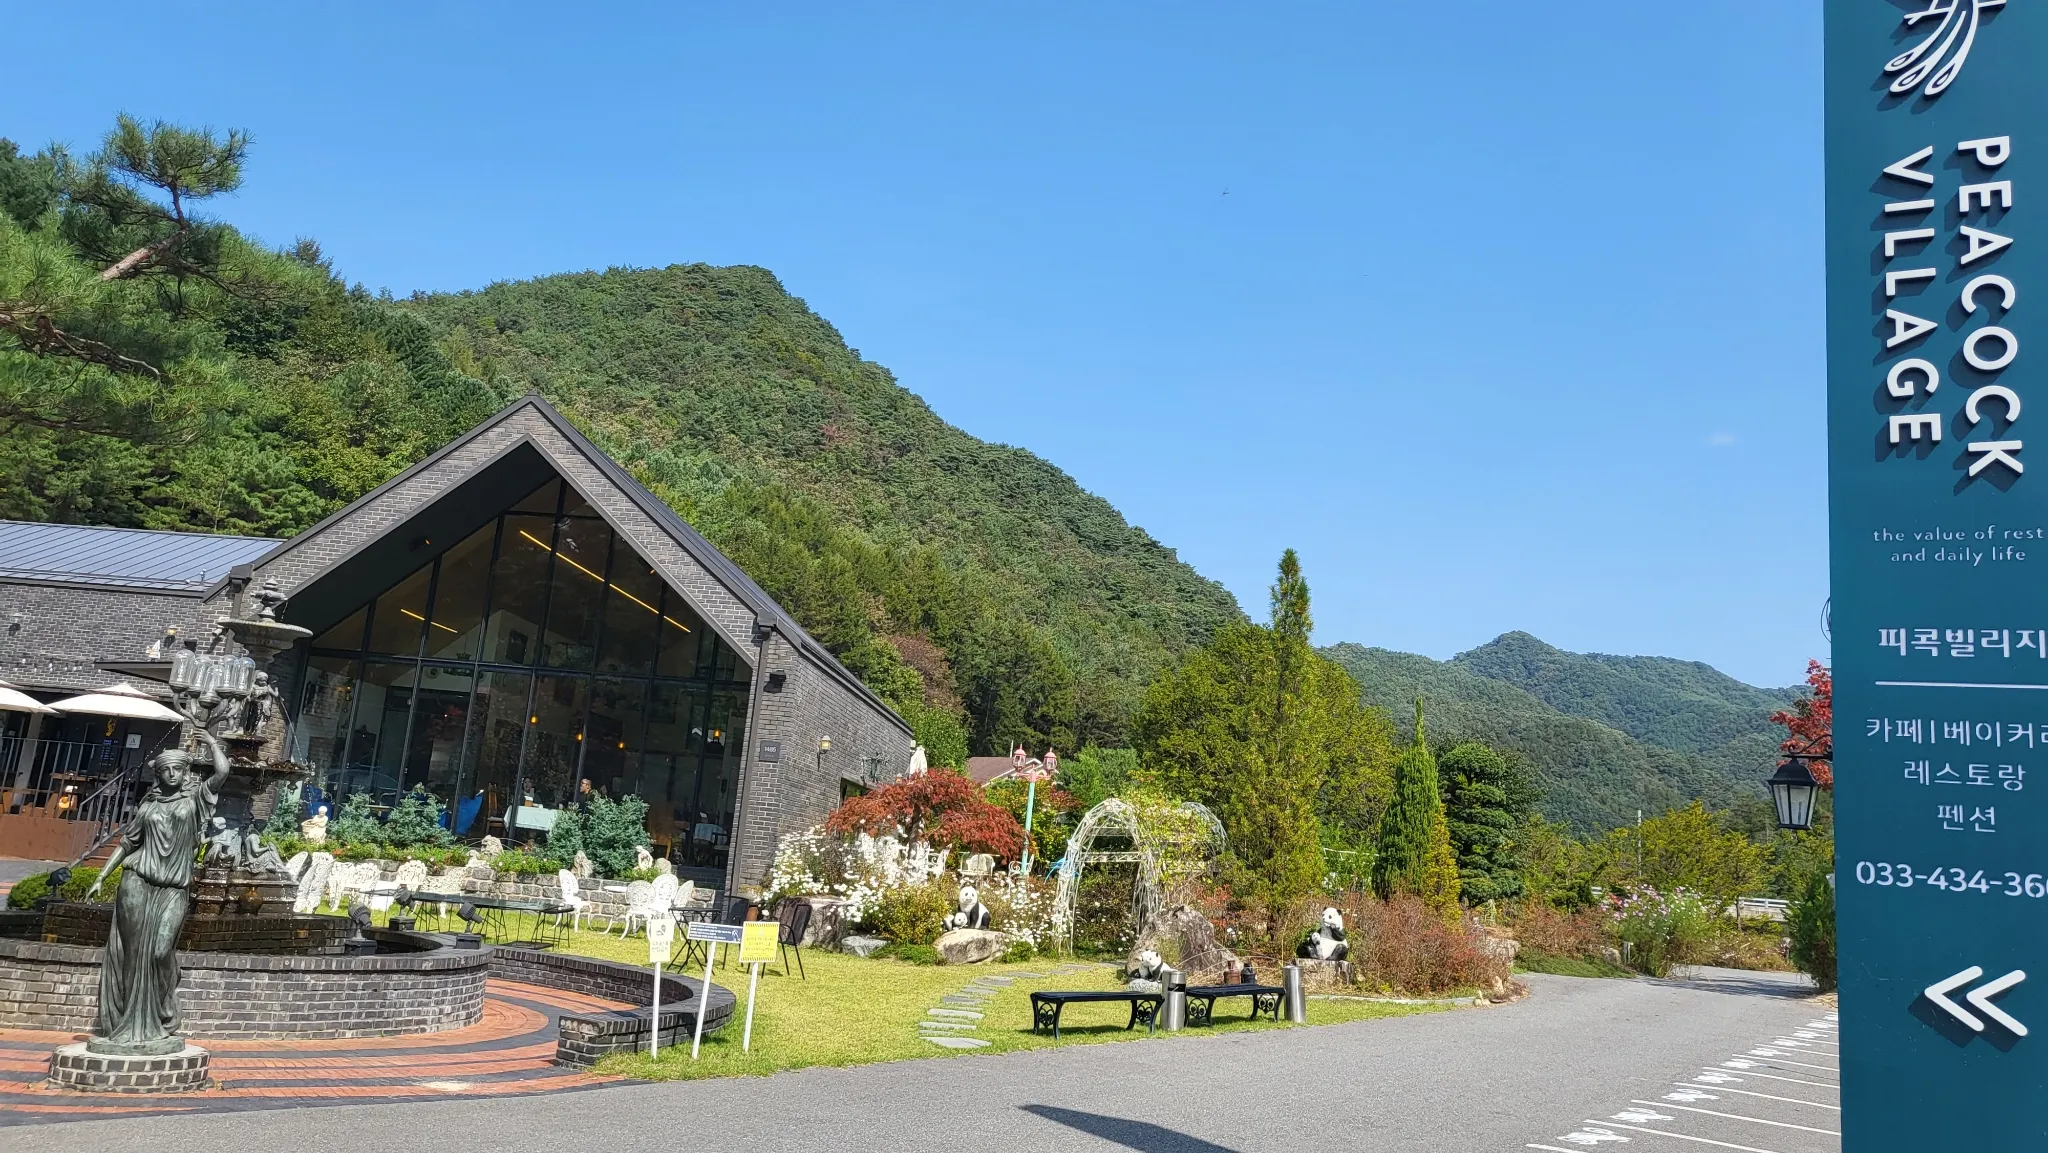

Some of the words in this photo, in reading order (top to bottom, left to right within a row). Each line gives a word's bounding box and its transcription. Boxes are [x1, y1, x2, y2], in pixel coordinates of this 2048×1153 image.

[1882, 145, 1942, 444] VILLAGE
[1957, 135, 2024, 477] PEACOCK
[1873, 527, 1905, 542] the
[1913, 526, 1966, 541] value
[1974, 525, 1996, 540] of
[2004, 526, 2045, 540] rest
[1891, 547, 1926, 562] and
[1934, 547, 1983, 567] daily
[1992, 546, 2027, 561] life
[1878, 628, 2047, 659] 피콕빌리지
[1903, 760, 2027, 792] 레스토랑
[1937, 804, 1997, 833] 펜션
[1856, 860, 2048, 898] 033-434-36
